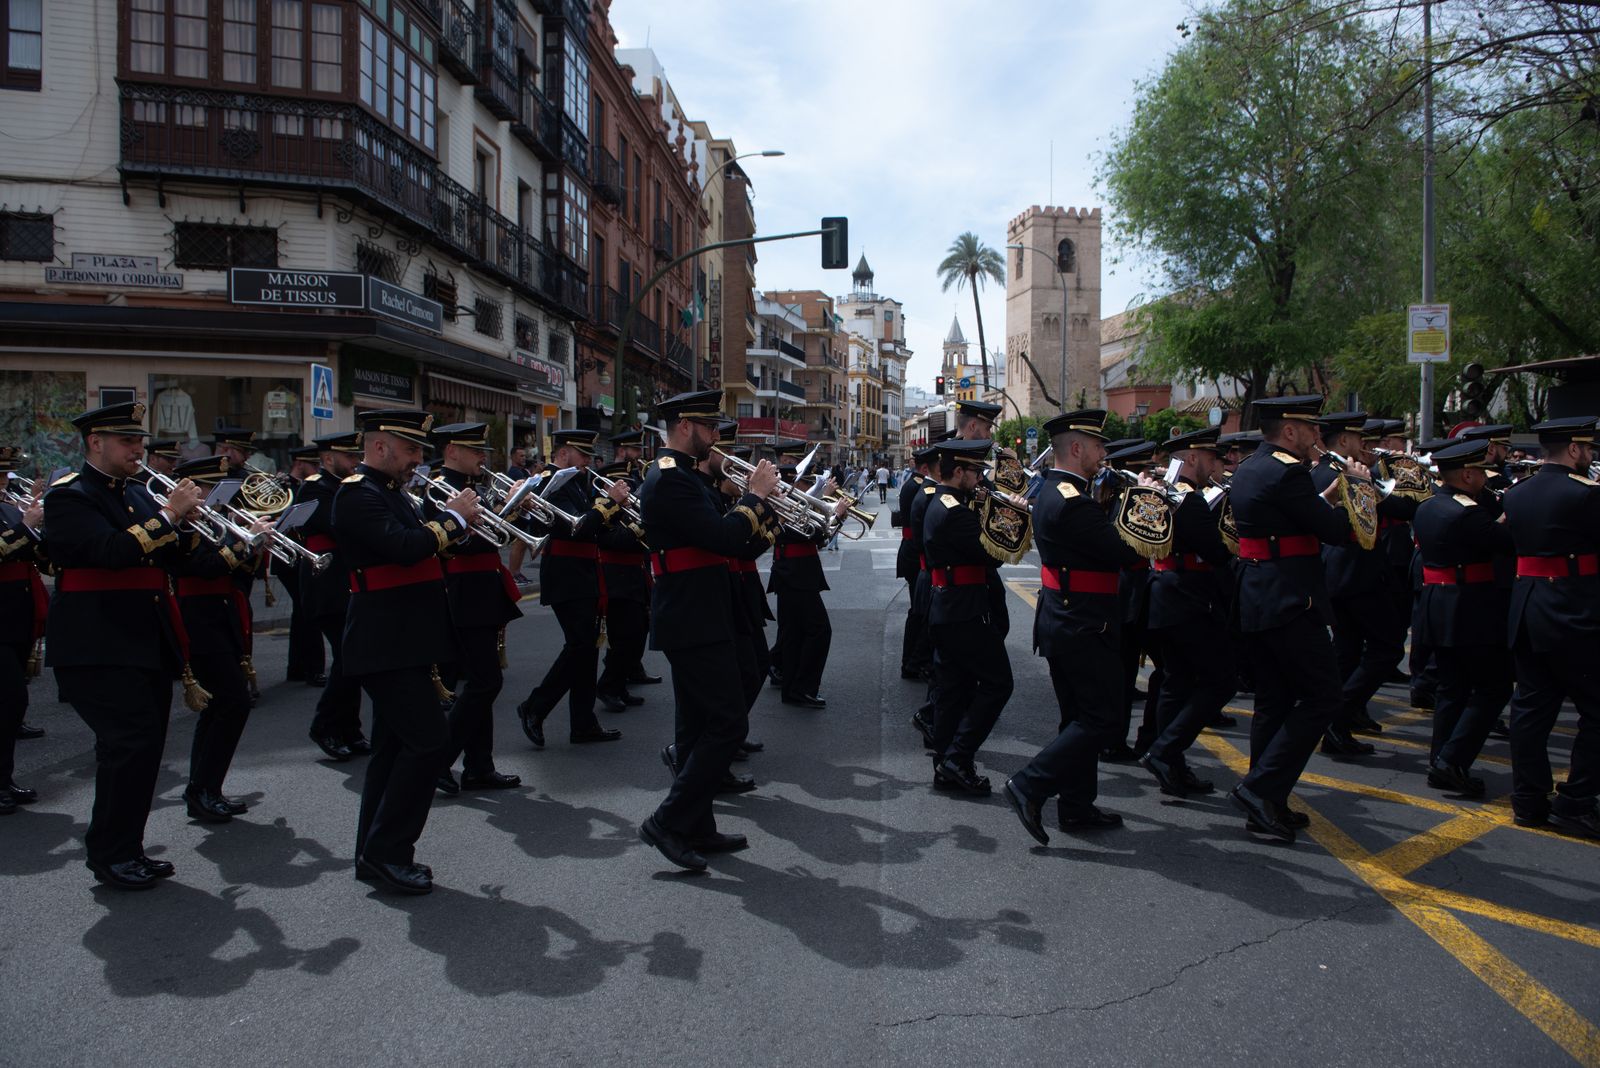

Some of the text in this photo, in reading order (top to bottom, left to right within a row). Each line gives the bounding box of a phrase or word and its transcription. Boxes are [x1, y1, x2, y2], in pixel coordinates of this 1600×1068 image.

[93, 256, 137, 268] PLAZA
[59, 270, 117, 283] JERONIMO
[122, 273, 180, 286] CORDOBA
[268, 273, 329, 287] MAISON
[260, 288, 336, 303] DE TISSUS
[381, 289, 434, 322] Rachel Carmona
[354, 368, 380, 382] MAISON
[381, 372, 390, 384] DE
